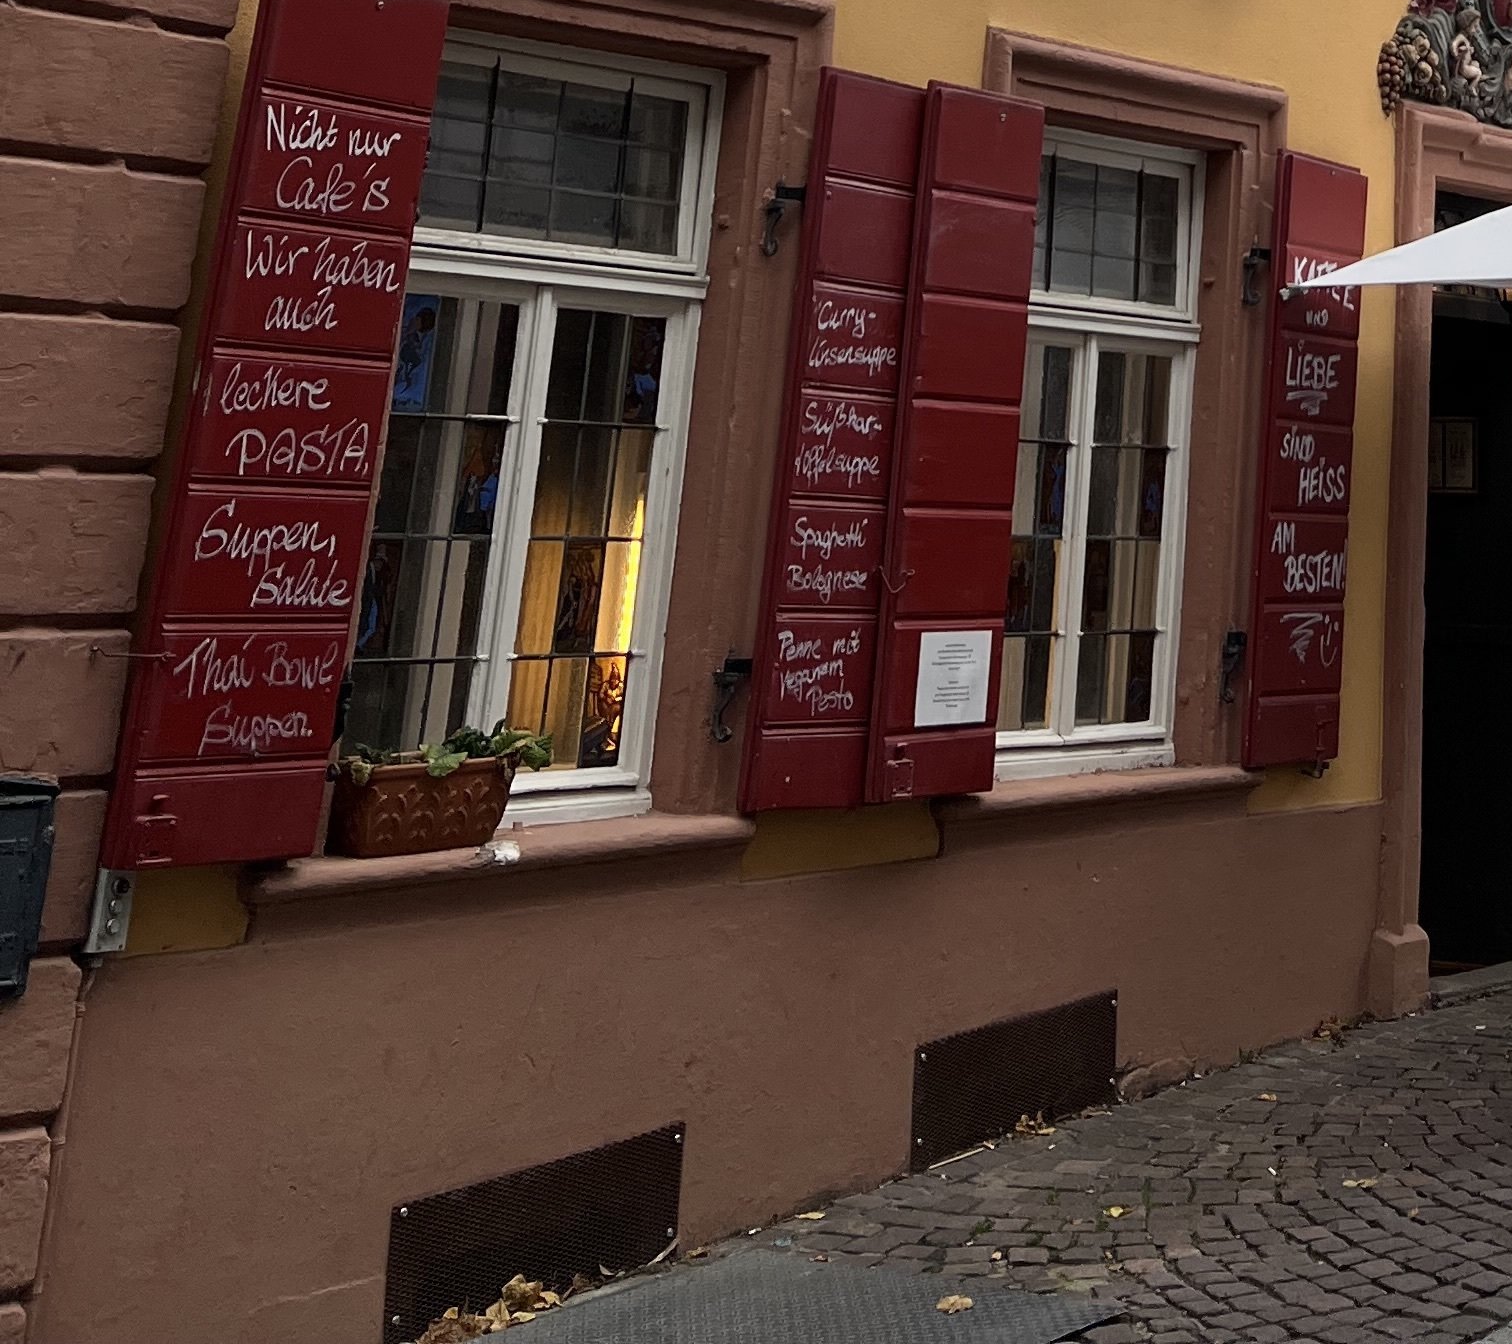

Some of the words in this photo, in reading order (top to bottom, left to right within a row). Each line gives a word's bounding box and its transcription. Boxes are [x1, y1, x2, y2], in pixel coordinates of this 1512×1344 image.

[266, 104, 339, 153] Nicht
[348, 127, 401, 157] nur
[245, 229, 308, 279] Wir
[313, 236, 400, 293] haben
[263, 286, 338, 332] auch
[790, 516, 869, 561] Spaghetti
[1271, 521, 1296, 554] AM
[787, 564, 868, 605] Bolognese
[173, 633, 257, 699] Thai
[778, 630, 822, 662] Penne
[833, 627, 862, 656] mit
[805, 678, 854, 717] Pesto
